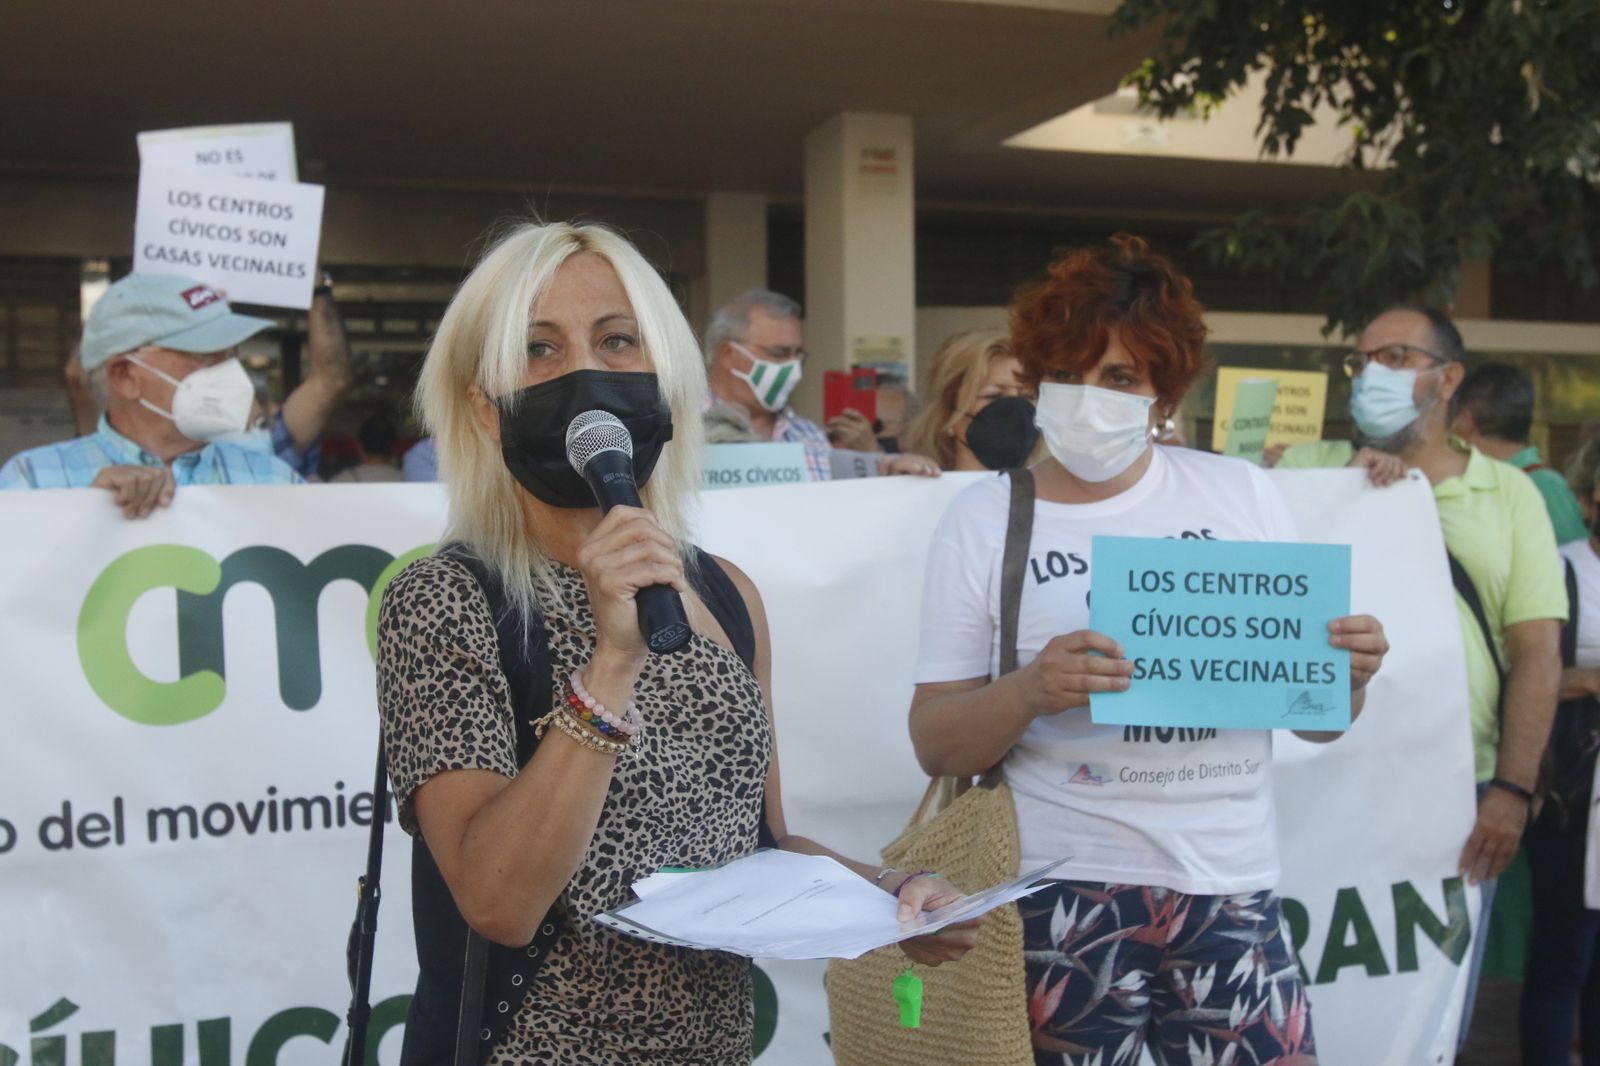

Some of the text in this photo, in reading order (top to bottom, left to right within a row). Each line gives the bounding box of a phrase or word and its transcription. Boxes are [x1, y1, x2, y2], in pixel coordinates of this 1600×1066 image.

[196, 149, 244, 165] NO ES
[168, 190, 293, 221] LOS CENTROS
[169, 217, 287, 248] CÍVICOS SON
[144, 245, 306, 279] CASAS VECINALES
[745, 465, 801, 483] CÍVICOS
[1030, 550, 1089, 585] LOS
[1128, 569, 1309, 597] LOS CENTROS
[1131, 608, 1302, 640] CÍVICOS SON
[1130, 657, 1337, 685] SAS VECINALES
[1119, 766, 1175, 787] Consejo
[1178, 764, 1195, 783] de
[1199, 758, 1242, 779] Distrito
[1244, 758, 1261, 774] Sur
[38, 796, 125, 850] del
